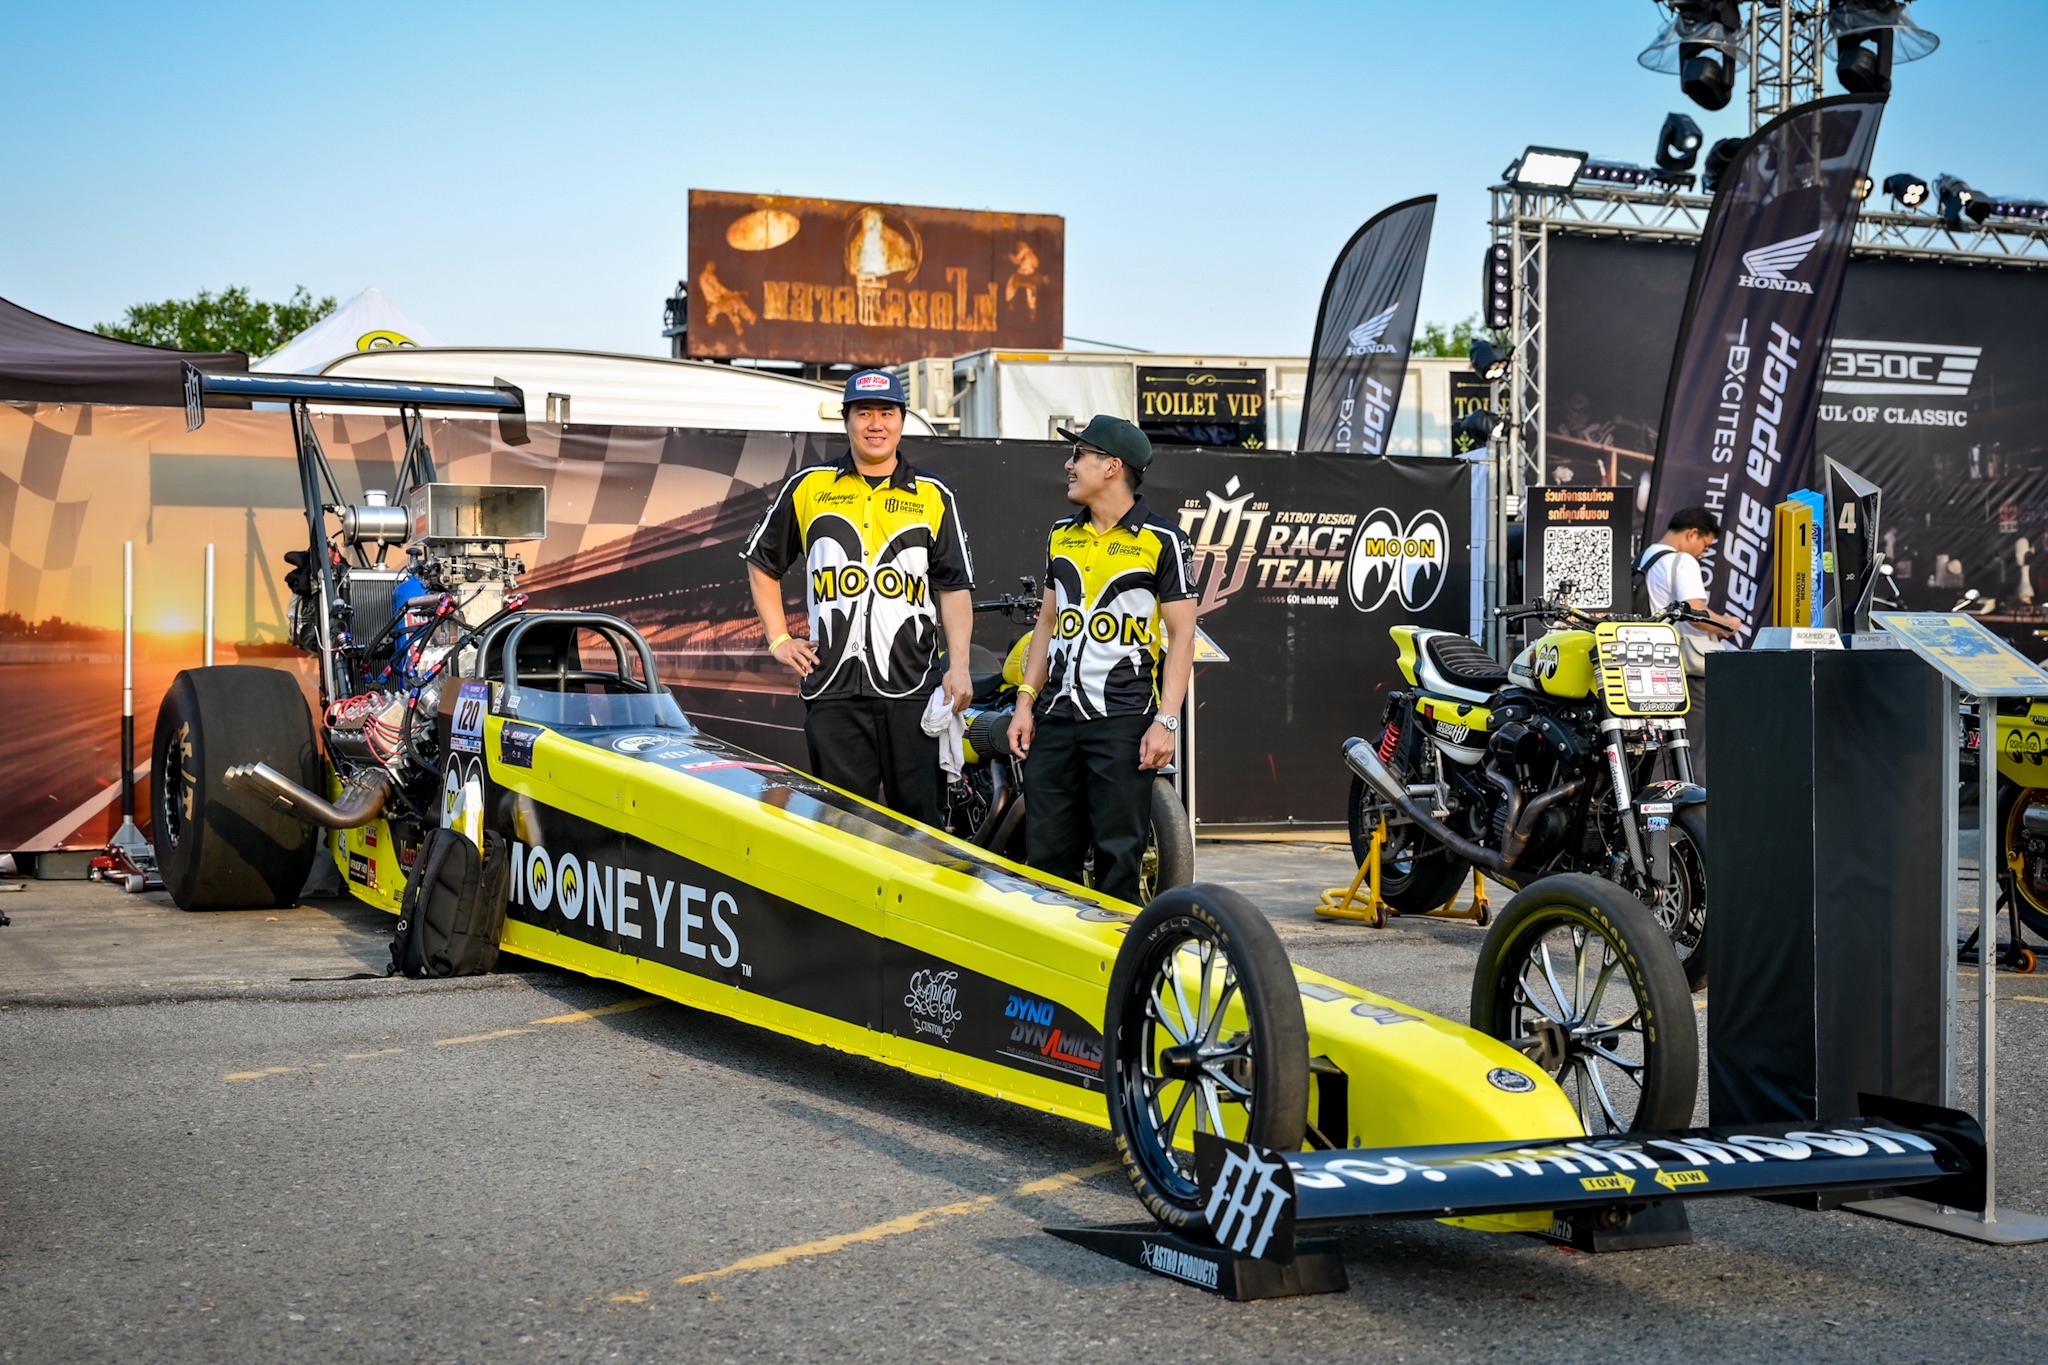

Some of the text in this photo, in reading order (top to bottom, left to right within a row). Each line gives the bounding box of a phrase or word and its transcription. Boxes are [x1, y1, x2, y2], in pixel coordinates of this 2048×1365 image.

[1738, 275, 1814, 295] HONDA
[1346, 343, 1397, 356] HONDA
[1142, 391, 1262, 417] TOILET VIP
[1746, 321, 1801, 488] Honda
[1852, 406, 1879, 423] OF
[1883, 408, 1968, 427] CLASSIC
[899, 506, 924, 515] DESIGN
[900, 501, 925, 509] FATBOY
[1184, 499, 1201, 508] EST.
[1252, 502, 1269, 510] 2011
[1275, 511, 1357, 526] FATBOY DESIGN
[1838, 502, 1857, 534] 4
[1263, 525, 1353, 558] RACE
[1799, 523, 1806, 546] 1
[1119, 549, 1140, 557] DESIGN
[1365, 538, 1435, 558] MOON
[812, 564, 925, 608] MOON
[1256, 559, 1345, 590] TEAM
[1300, 595, 1316, 605] with
[1601, 641, 1681, 669] 333
[457, 700, 480, 732] 120
[1639, 702, 1675, 711] MOON
[2009, 740, 2037, 751] MOON
[1610, 765, 1623, 807] idemitsu
[509, 841, 740, 968] MOONEYES
[1147, 917, 1190, 942] WELD
[1192, 903, 1229, 944] EAGLE
[1590, 906, 1656, 1043] GOODYEAR
[1005, 995, 1055, 1026] DYNO
[921, 1020, 943, 1036] CUSTOM
[1010, 1021, 1104, 1063] DYNAMICS
[1586, 1177, 1622, 1190] TOW
[1667, 1171, 1703, 1185] TOW
[1151, 1244, 1219, 1286] ASTRO PRODUCTS
